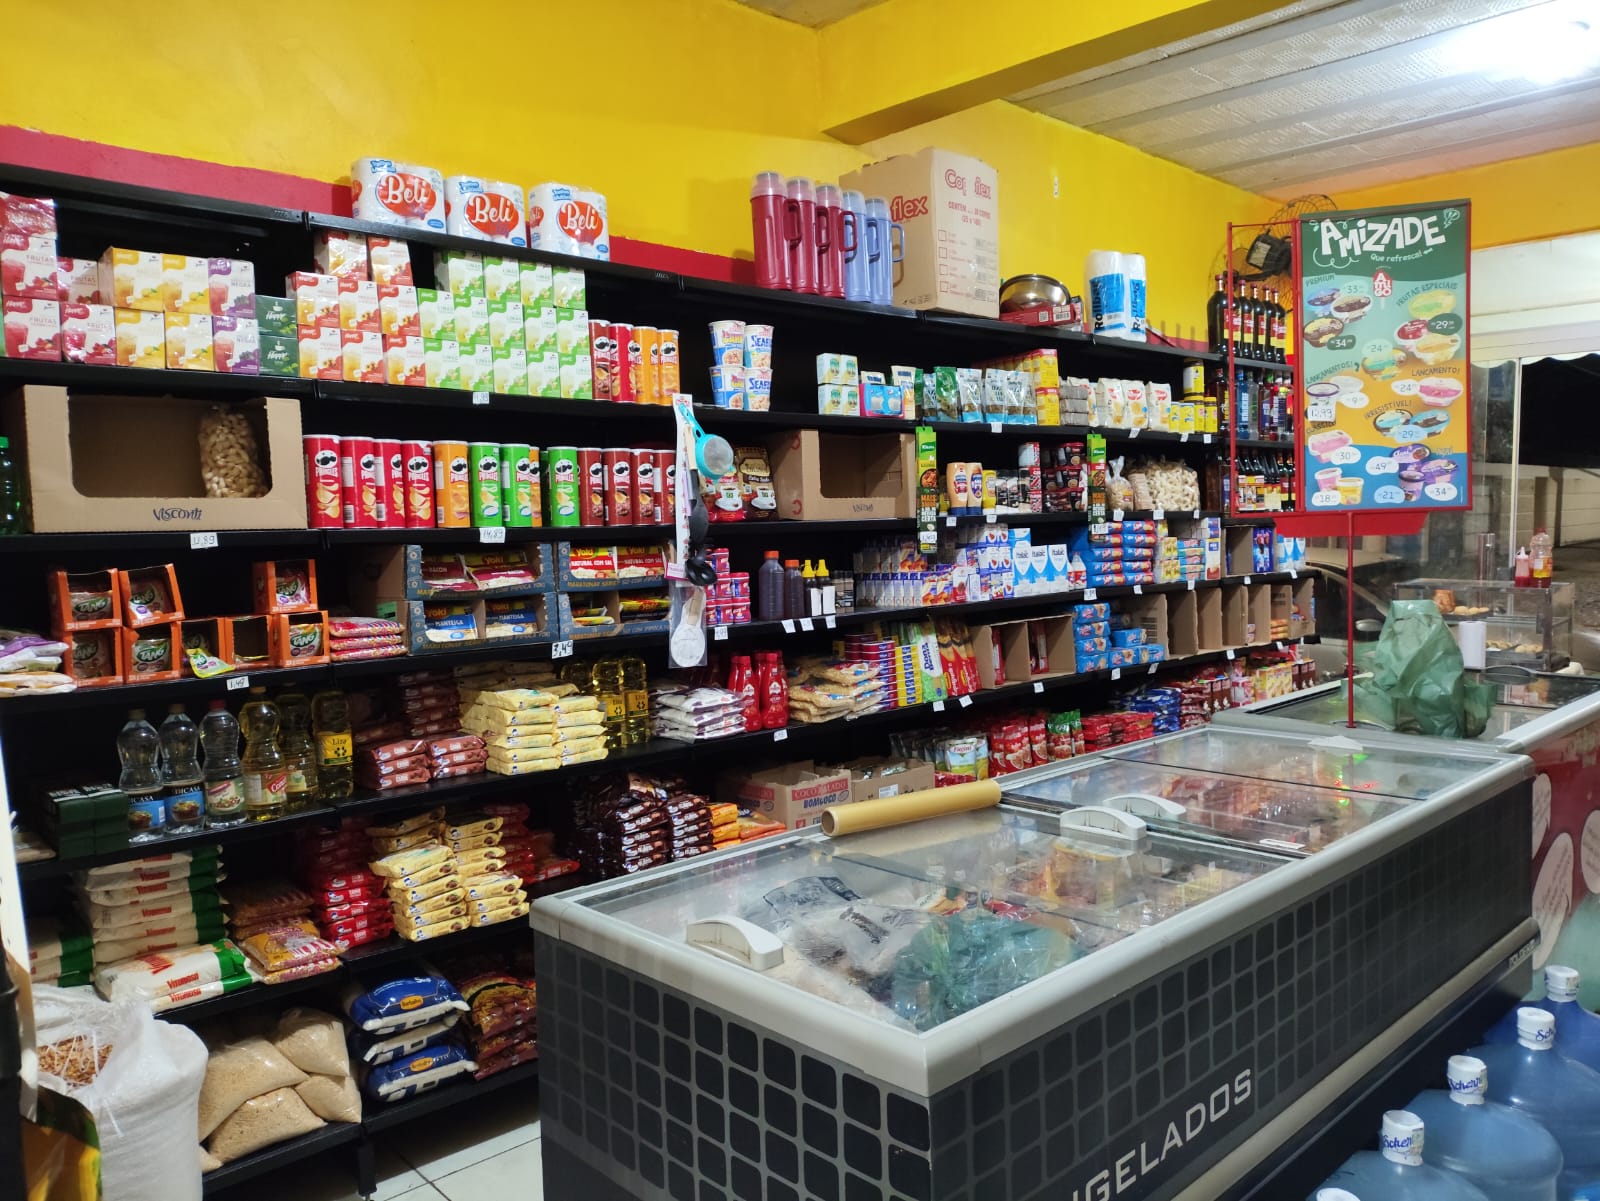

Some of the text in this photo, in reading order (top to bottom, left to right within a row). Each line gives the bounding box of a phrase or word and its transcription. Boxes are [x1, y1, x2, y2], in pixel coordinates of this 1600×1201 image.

[380, 175, 430, 204] Beli
[469, 196, 514, 224] Beli
[562, 204, 600, 230] Beli
[1436, 320, 1448, 330] 29
[153, 508, 202, 521] Visconti
[294, 632, 314, 646] TANG
[140, 648, 165, 660] TANG
